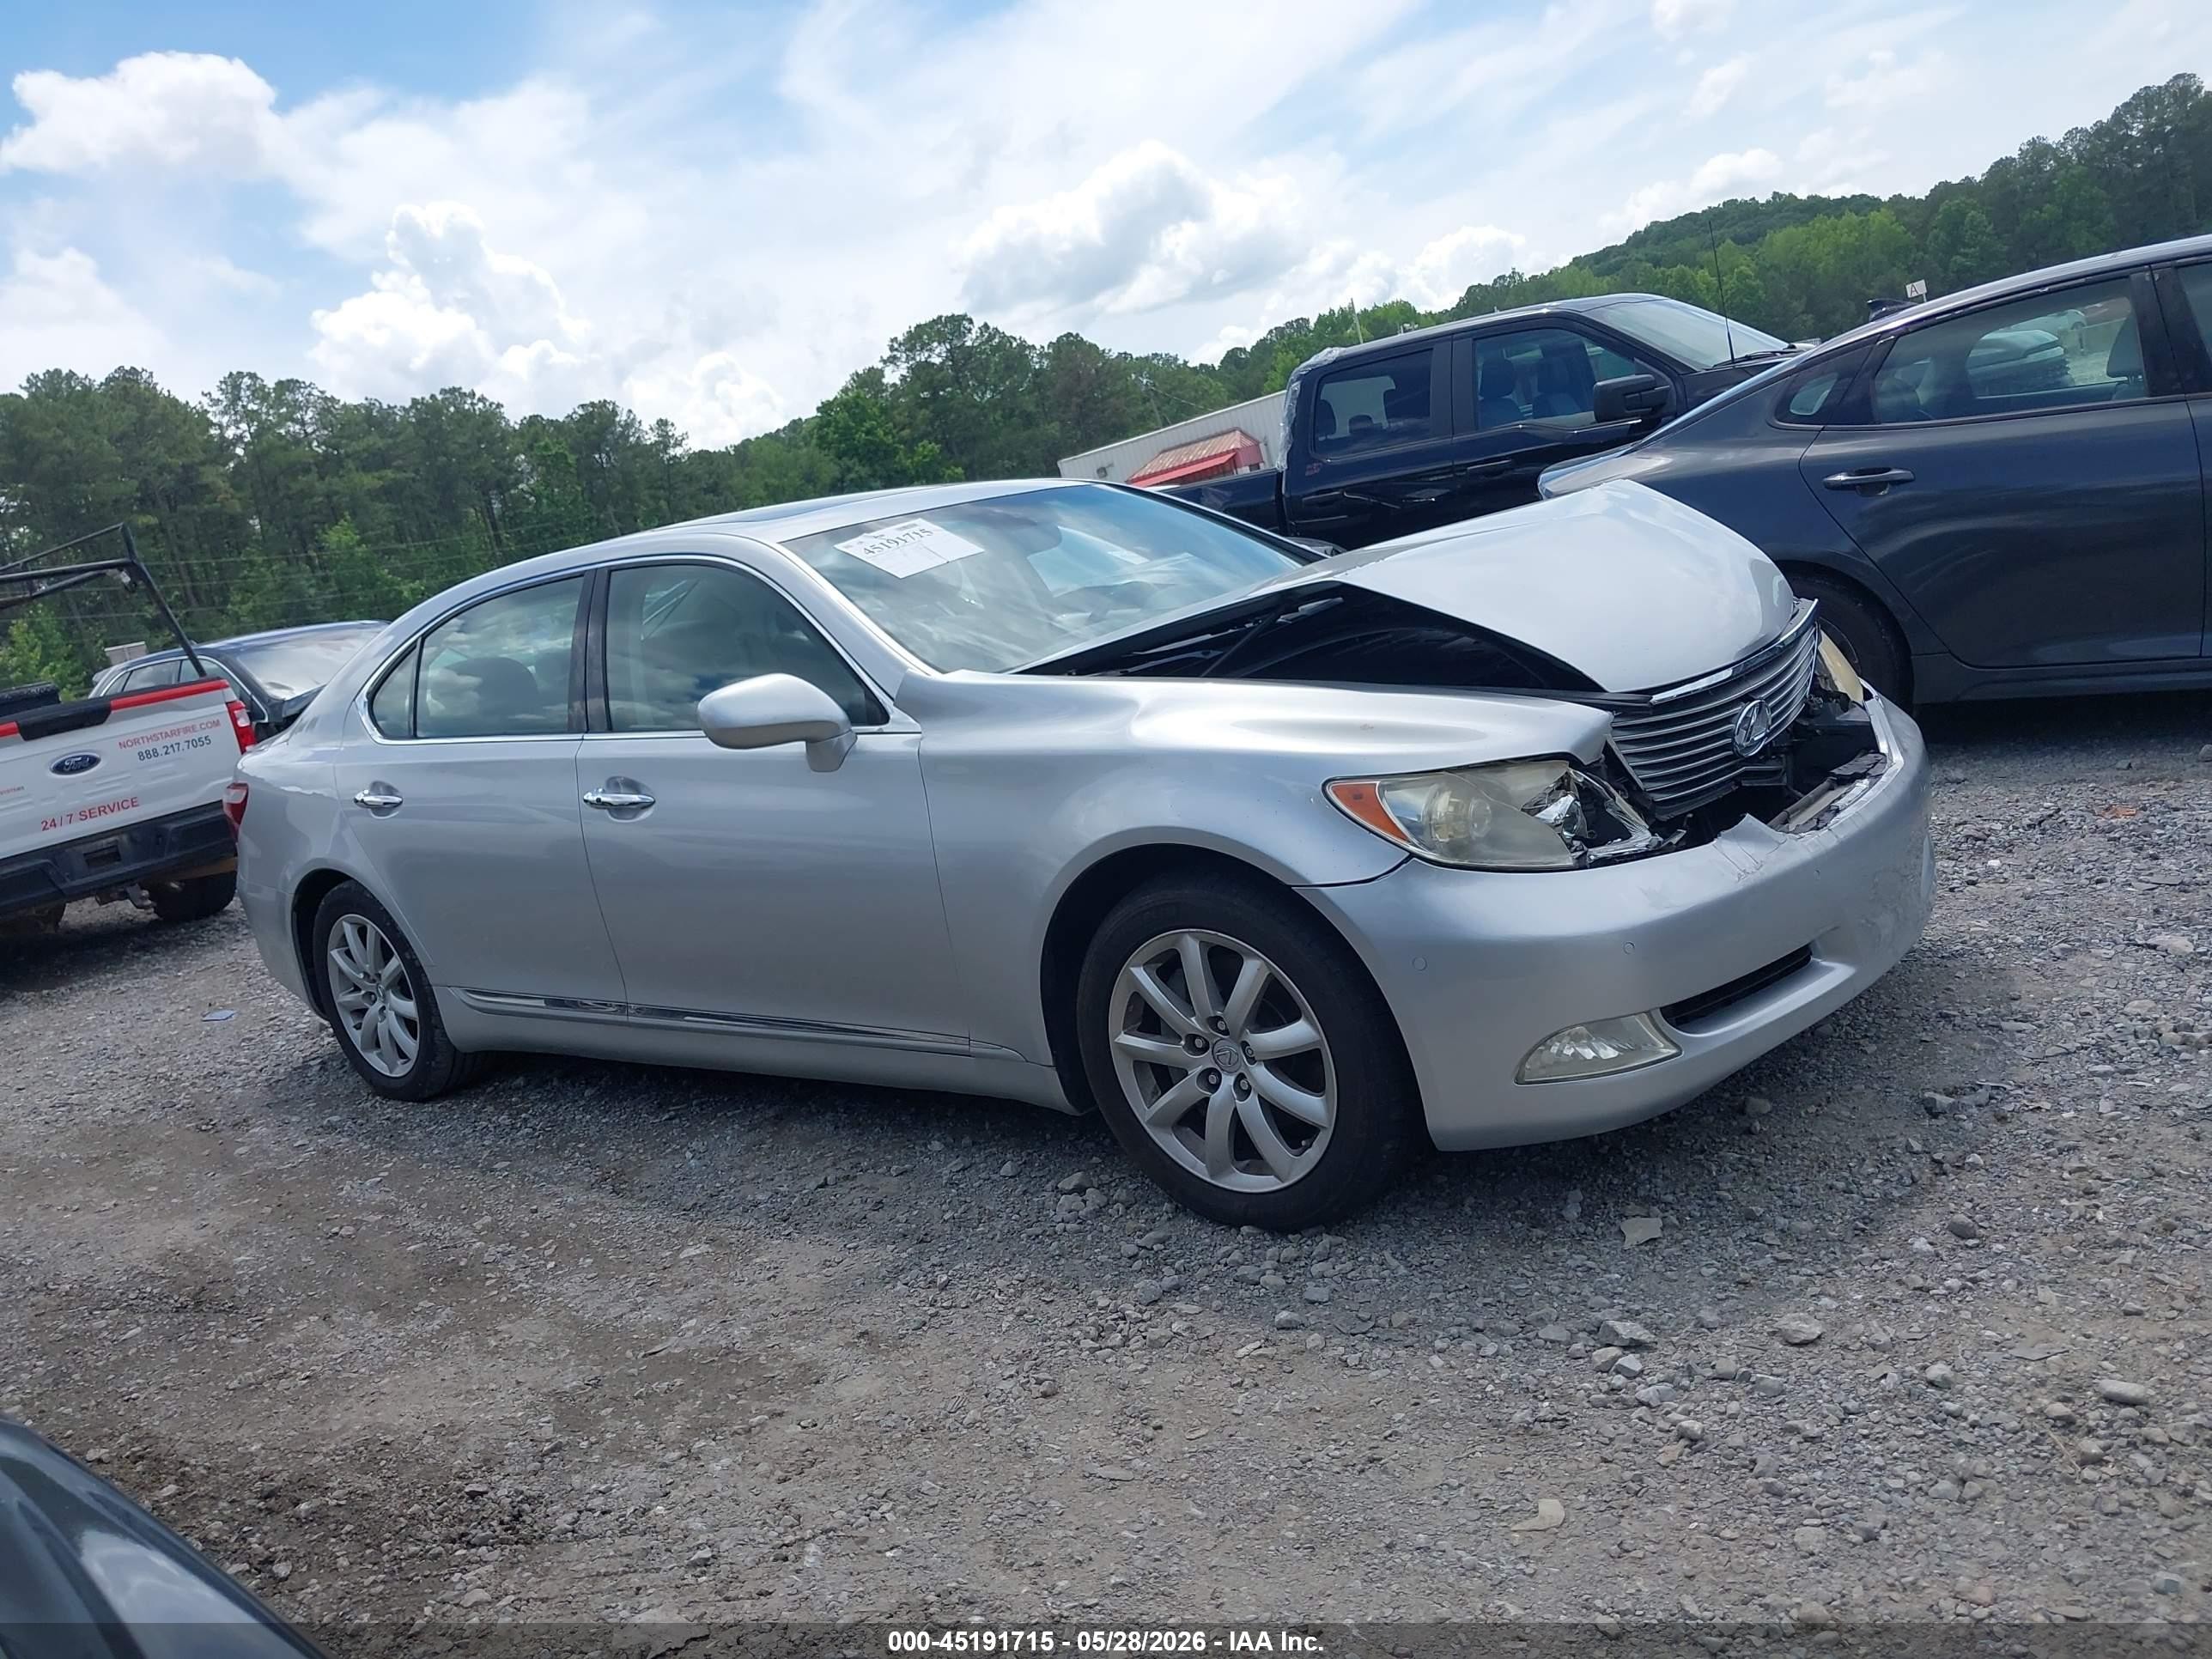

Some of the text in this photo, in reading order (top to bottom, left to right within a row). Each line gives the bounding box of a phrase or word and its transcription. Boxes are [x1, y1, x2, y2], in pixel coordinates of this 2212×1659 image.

[1910, 284, 1918, 296] A
[118, 720, 221, 750] NORTHSTARFIRE.COM
[137, 735, 212, 762] 888.217.7055
[79, 797, 139, 821] SERVICE
